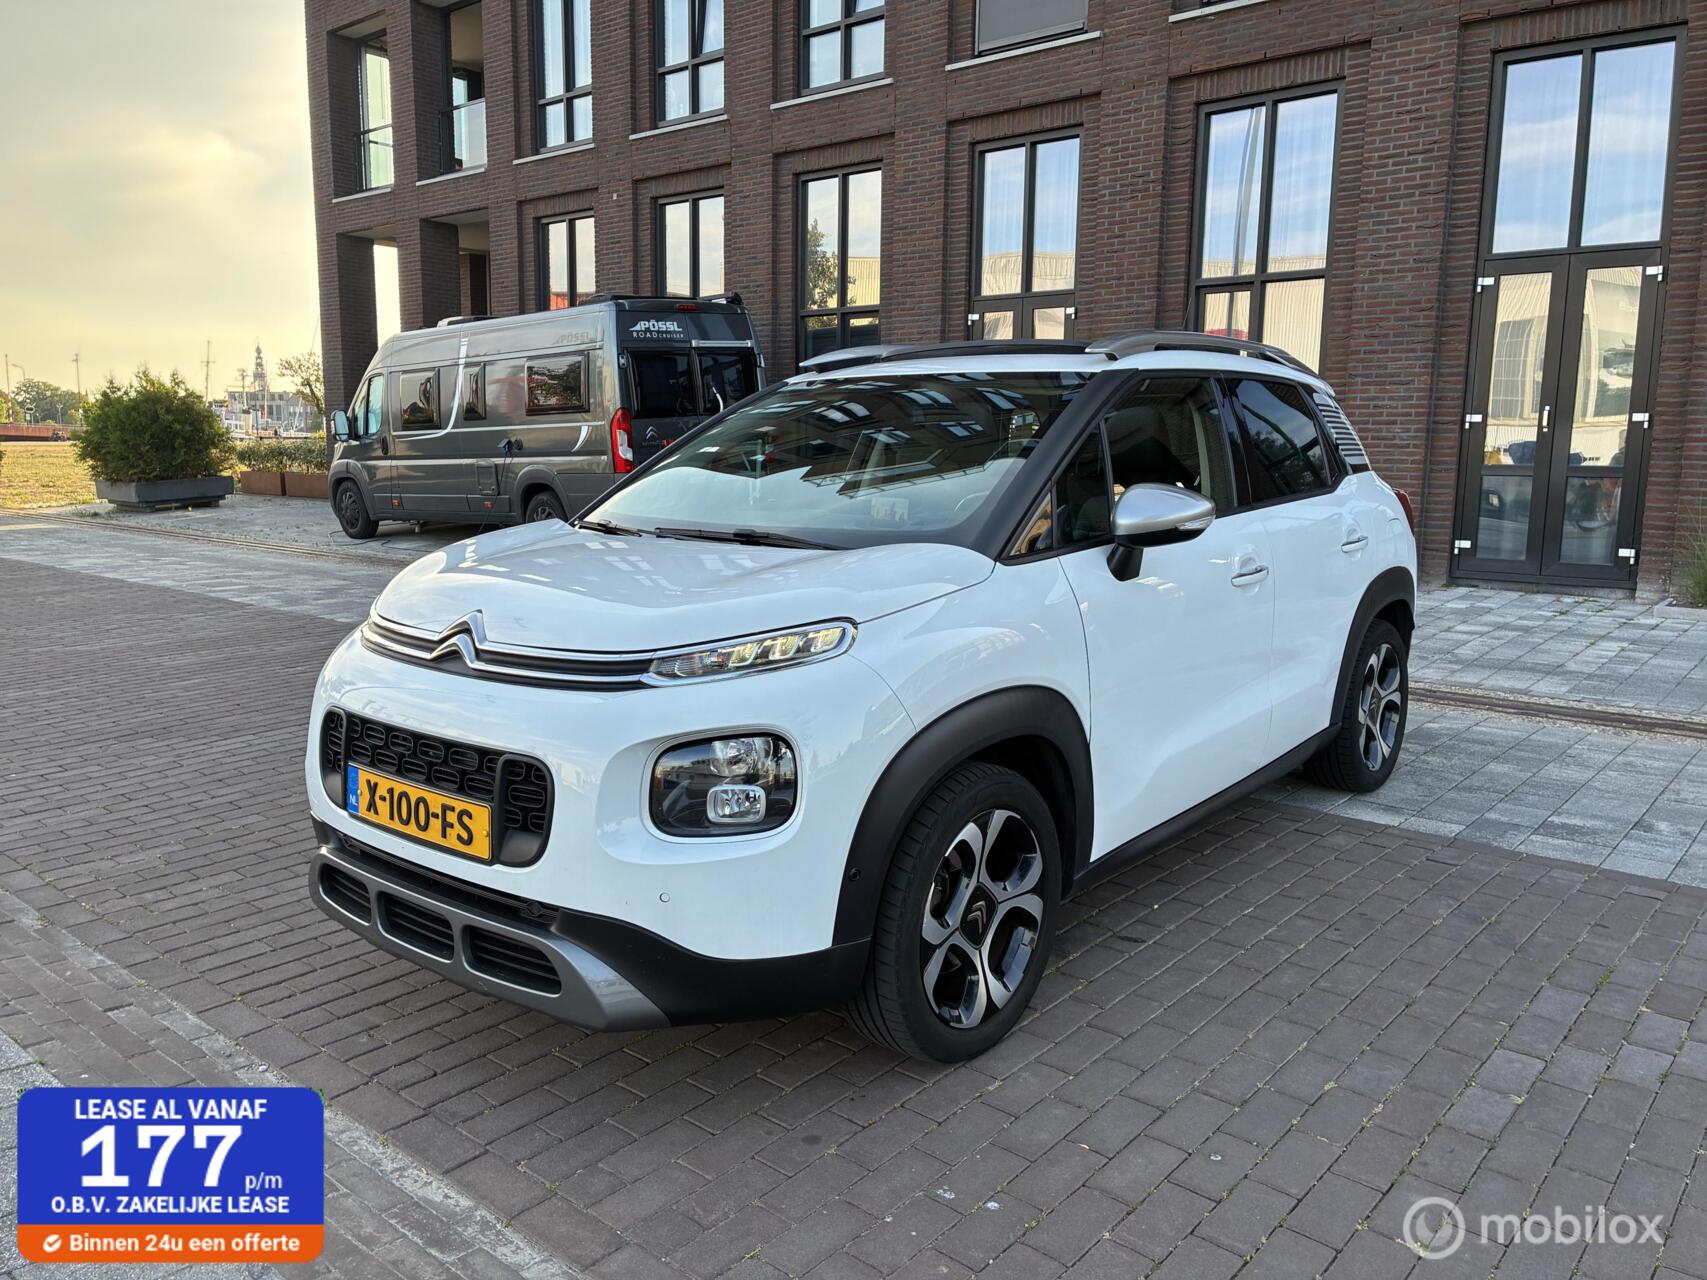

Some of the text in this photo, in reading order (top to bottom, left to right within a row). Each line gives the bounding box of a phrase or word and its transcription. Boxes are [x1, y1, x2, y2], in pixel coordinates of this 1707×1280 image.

[640, 320, 683, 331] PÖSSL
[349, 793, 358, 807] NL
[365, 779, 473, 846] X-100-FS
